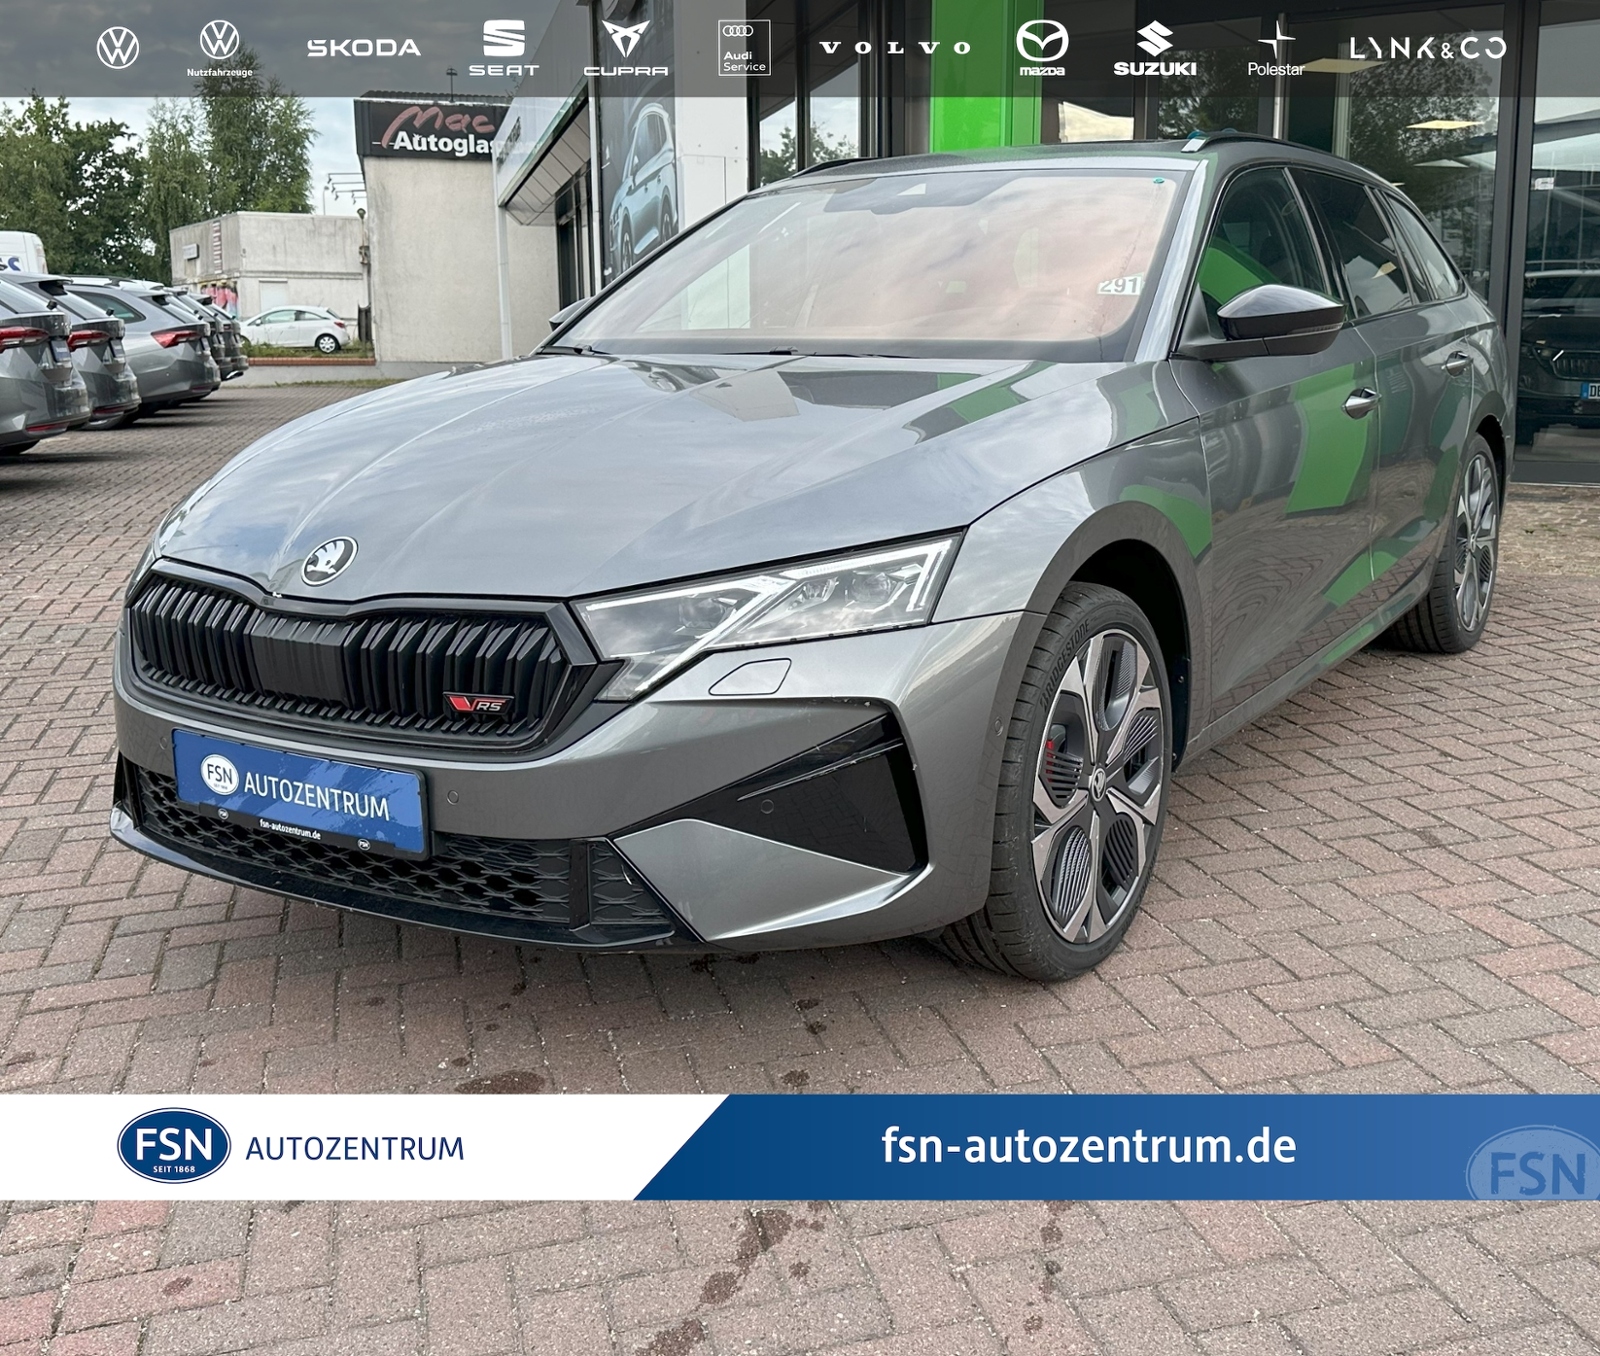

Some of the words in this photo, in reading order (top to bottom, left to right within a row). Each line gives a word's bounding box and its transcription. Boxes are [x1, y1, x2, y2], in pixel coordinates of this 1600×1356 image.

[381, 106, 495, 149] Mac
[1100, 277, 1138, 293] 291
[207, 763, 233, 785] FSN
[244, 772, 390, 821] AUTOZENTRUM
[259, 818, 322, 840] fsn-autozentrum.de
